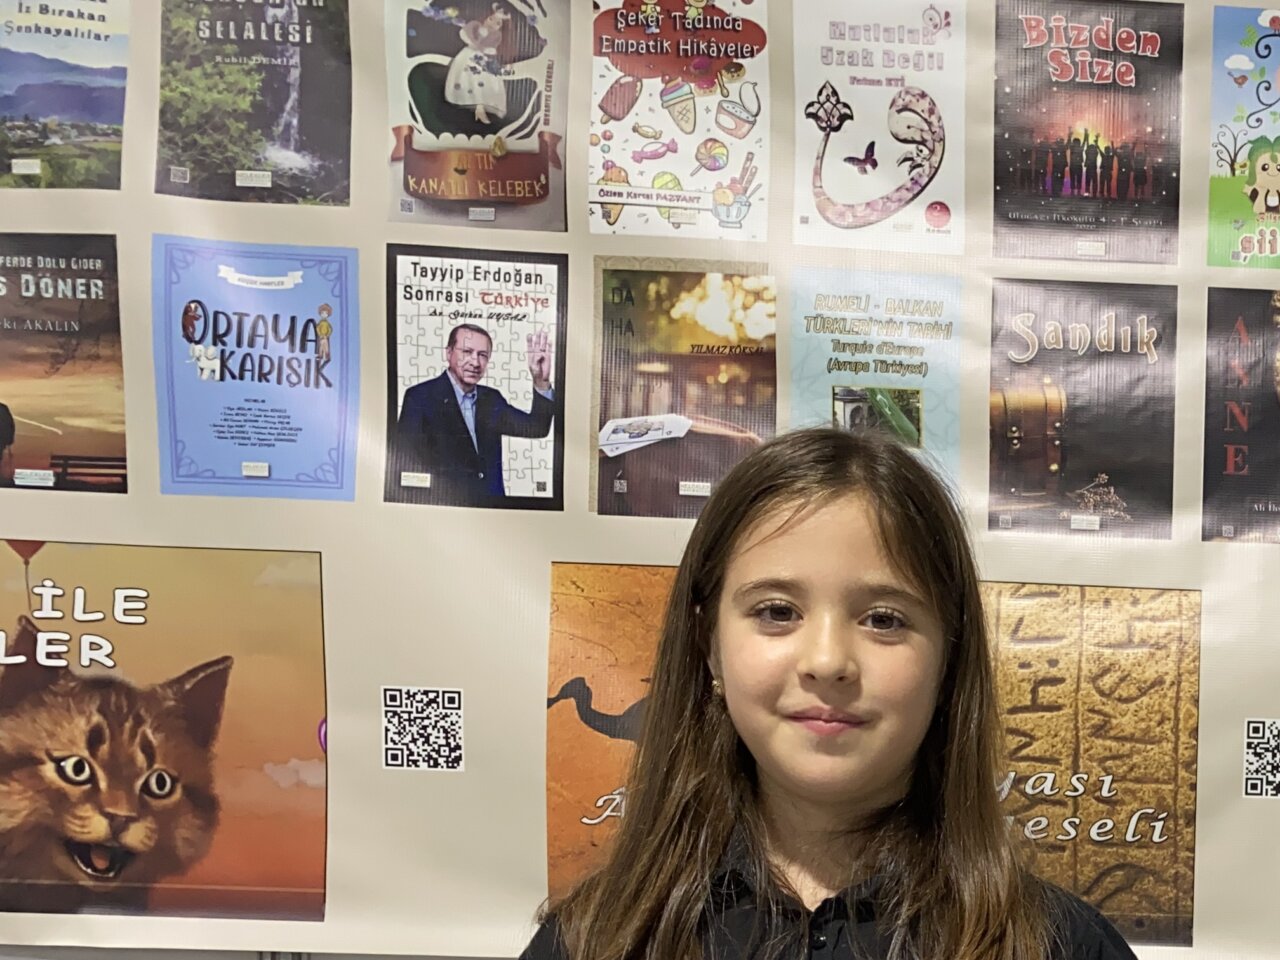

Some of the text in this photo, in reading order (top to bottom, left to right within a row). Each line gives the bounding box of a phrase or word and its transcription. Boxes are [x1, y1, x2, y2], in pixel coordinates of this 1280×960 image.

[38, 4, 107, 22] Bırakan
[616, 9, 743, 32] Şeker Tadında
[199, 19, 312, 44] ŞELALESİ
[1018, 15, 1161, 58] Bizden
[601, 35, 760, 58] Empatik Hikâyeler
[1047, 48, 1136, 88] Size
[407, 174, 544, 197] KANATLI KELEBEK
[37, 255, 66, 269] DOLU
[410, 261, 544, 287] Tayyip Erdoğan
[21, 273, 104, 300] DÖNER
[403, 284, 470, 304] Sonrası
[814, 293, 871, 314] RUMELİ
[884, 297, 945, 318] BALKAN
[24, 319, 80, 332] AKALIN
[181, 299, 321, 355] ORTAYA
[906, 319, 954, 341] TARİHİ
[690, 343, 728, 355] YILMAZ
[831, 338, 926, 358] Turquie d'Europe
[1008, 311, 1159, 365] Sandık
[219, 348, 334, 389] KARIŞIK
[826, 357, 871, 375] (Avrupa
[32, 579, 149, 625] İLE
